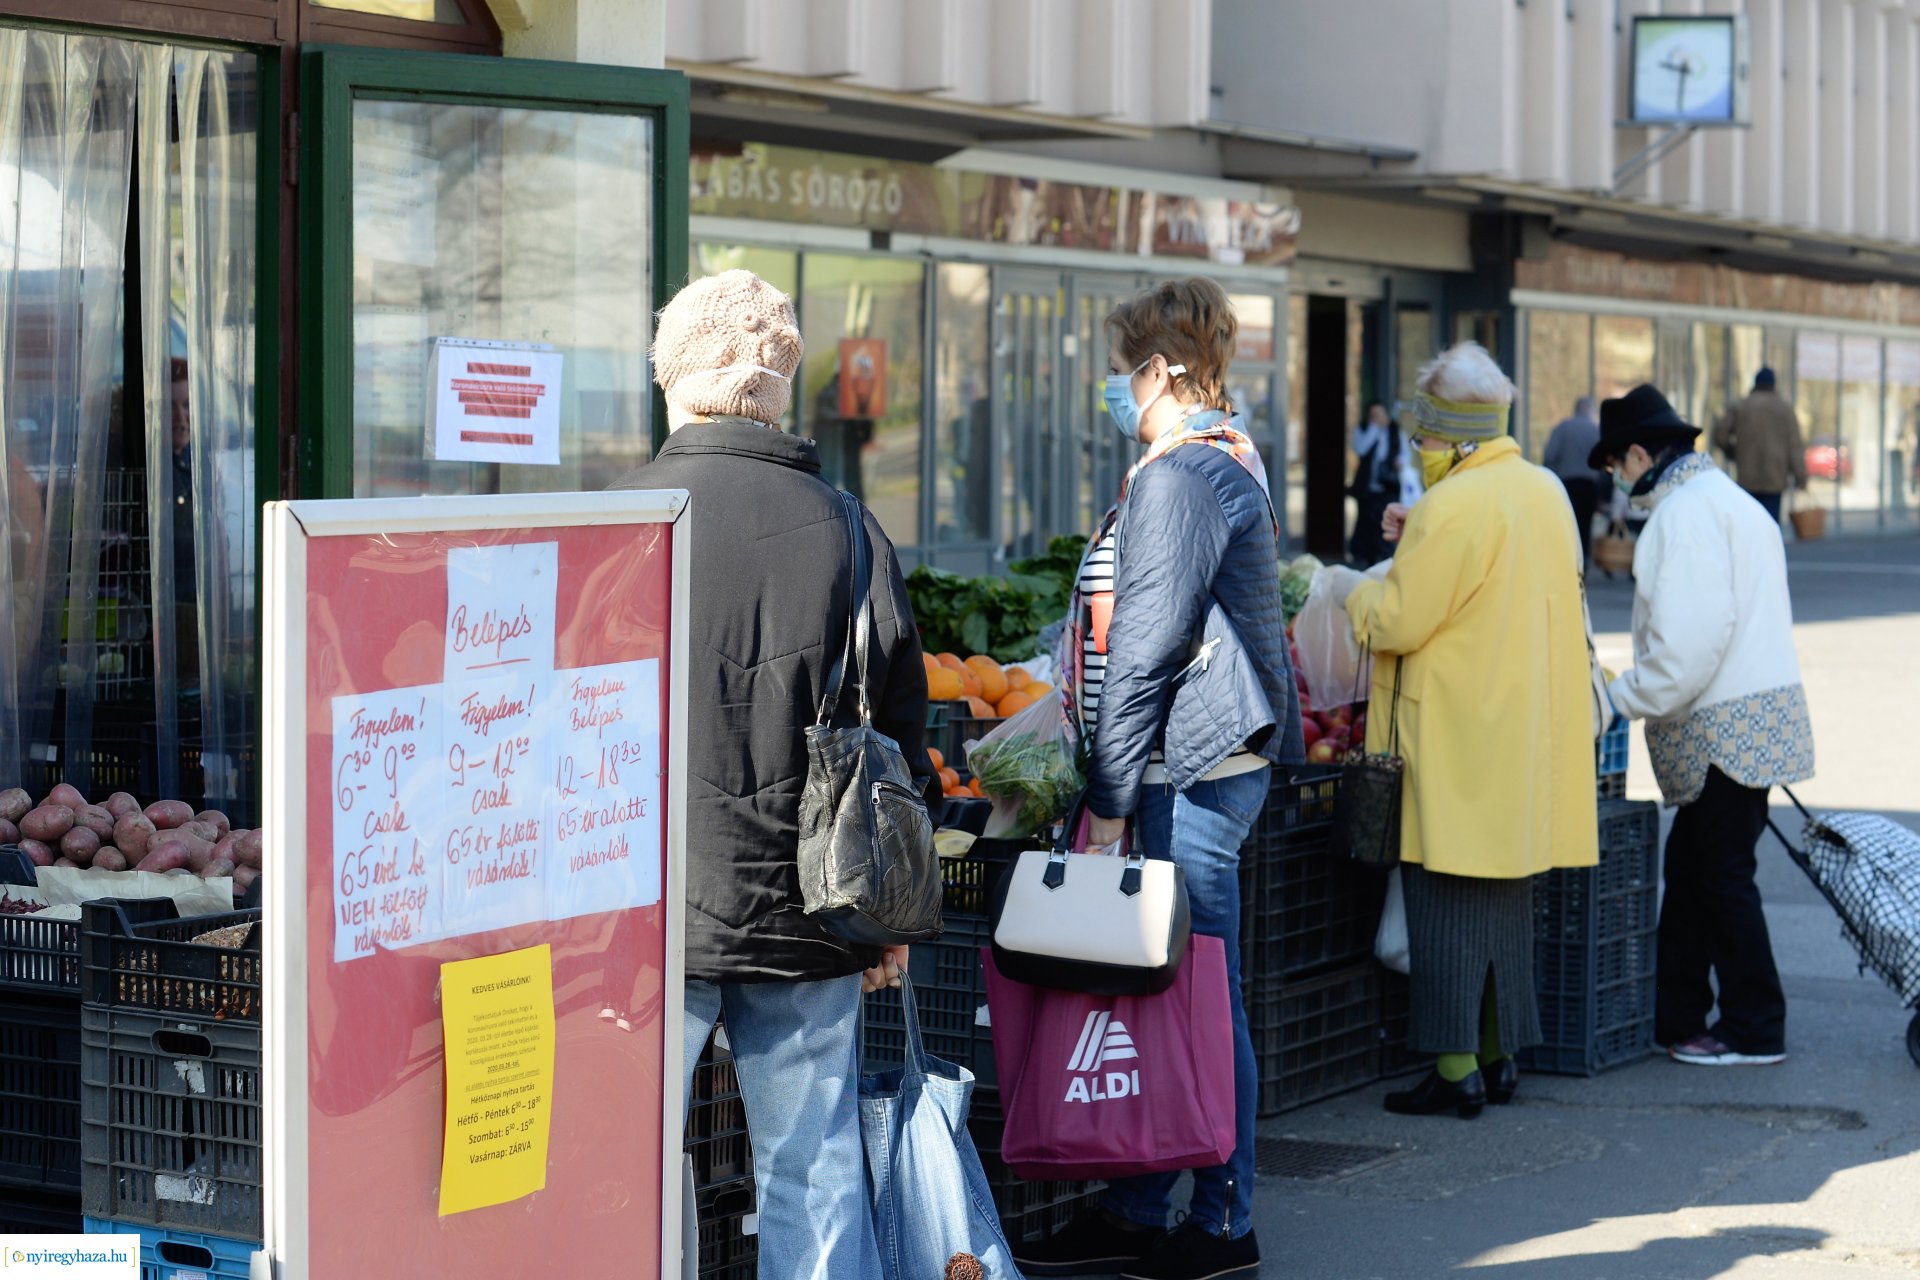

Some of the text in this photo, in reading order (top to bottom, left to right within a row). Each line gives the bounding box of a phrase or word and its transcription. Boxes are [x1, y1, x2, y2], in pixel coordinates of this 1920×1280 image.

[452, 603, 531, 658] Belépés
[349, 696, 425, 750] Figyelem!
[460, 683, 535, 737] Figyelem!
[558, 807, 577, 841] 65
[447, 825, 473, 865] 65
[341, 845, 373, 897] 65
[341, 897, 375, 926] NEM
[472, 983, 495, 995] KEDVES
[470, 1090, 502, 1104] Hétköznapi
[503, 1087, 519, 1098] nyitva
[1064, 1069, 1140, 1103] ALDI
[457, 1113, 479, 1127] Hétfő
[485, 1106, 510, 1120] Péntek
[469, 1130, 504, 1145] Szombat:
[469, 1140, 532, 1164] Vasárnap: ZÁRVA
